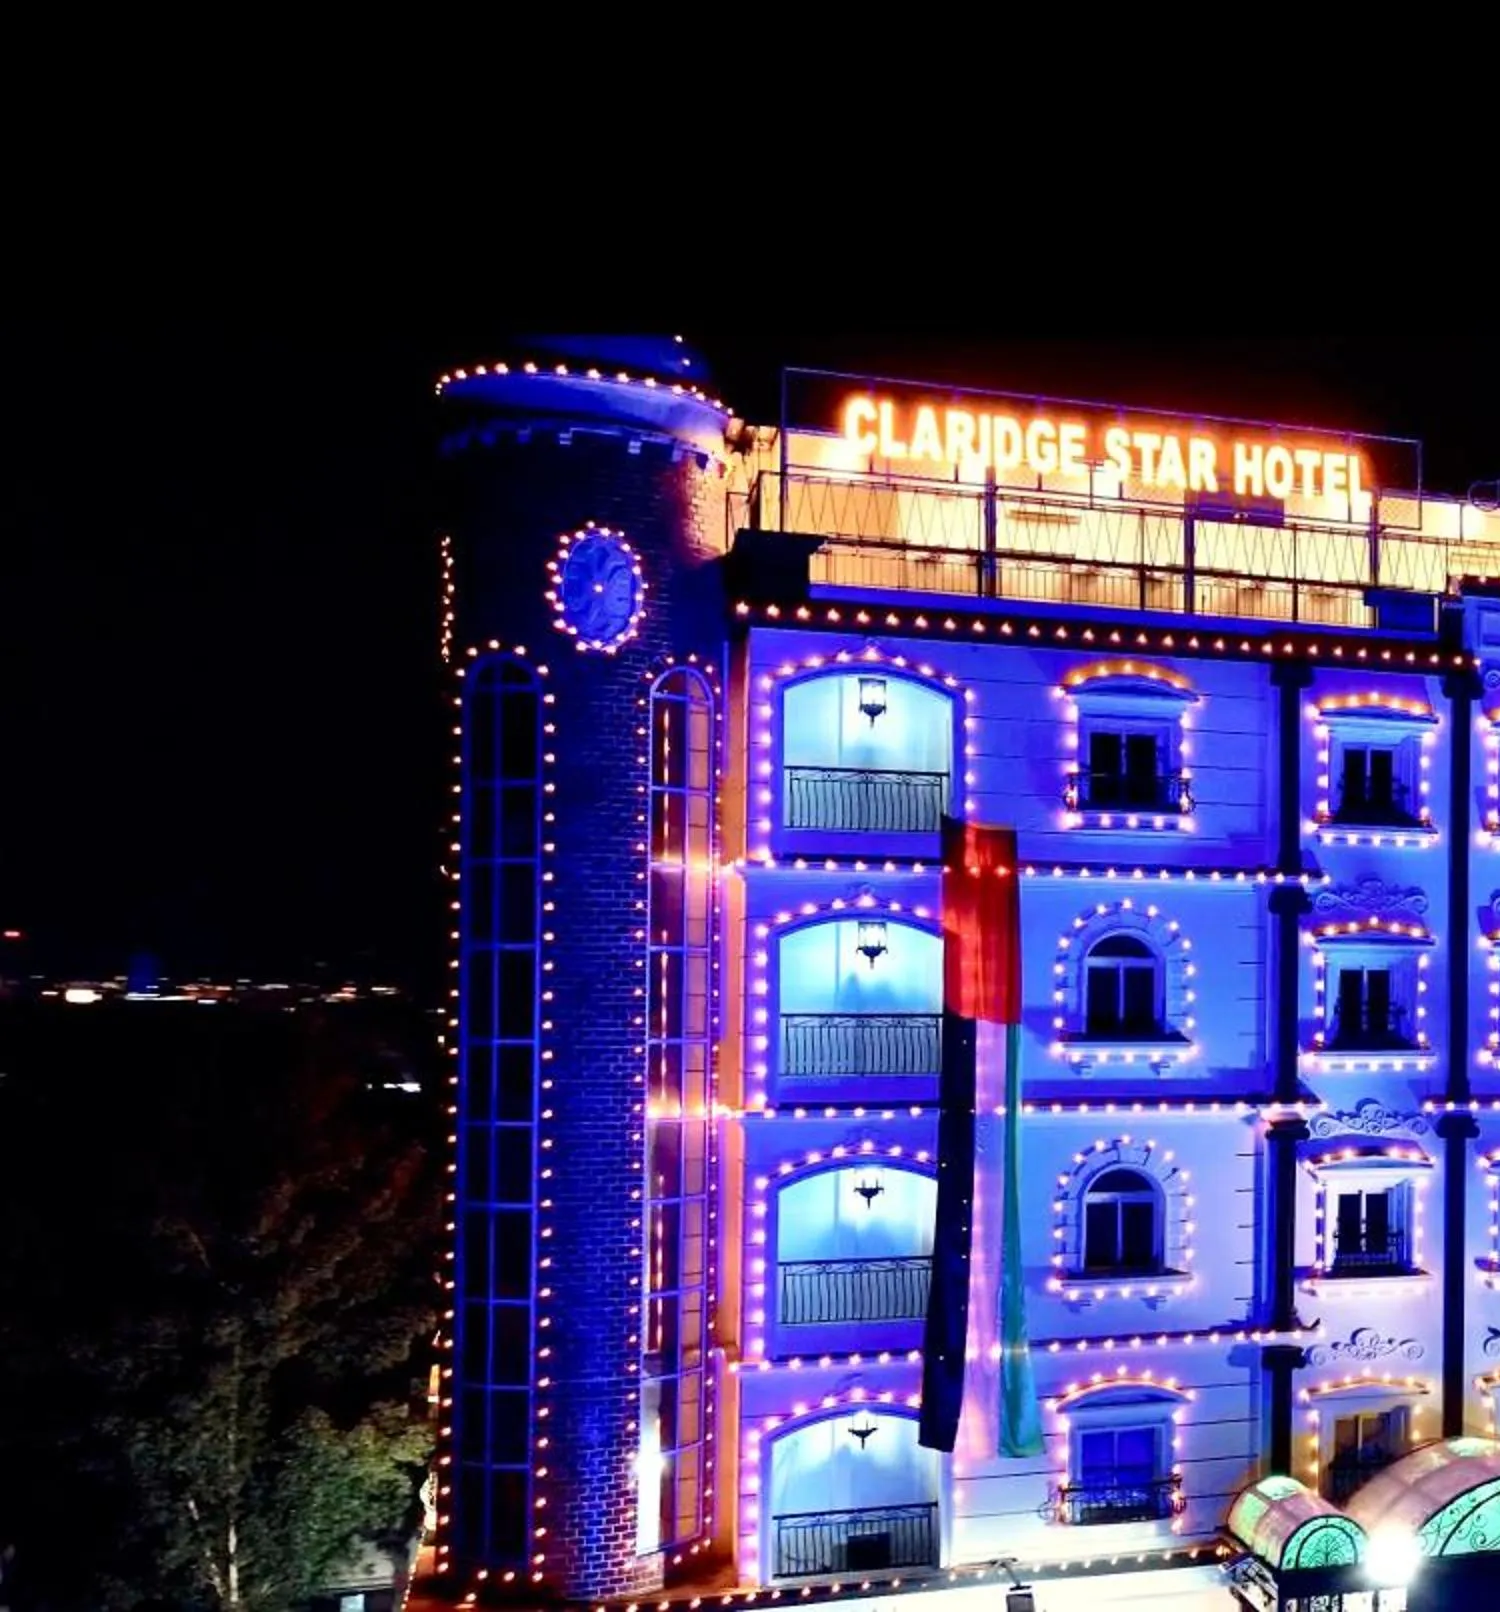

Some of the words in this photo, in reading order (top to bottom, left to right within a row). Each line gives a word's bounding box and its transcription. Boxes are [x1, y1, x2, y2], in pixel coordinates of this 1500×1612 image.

[843, 396, 1087, 476] CLARIDGE
[1104, 427, 1219, 492] STAR
[1233, 442, 1373, 507] HOTEL
